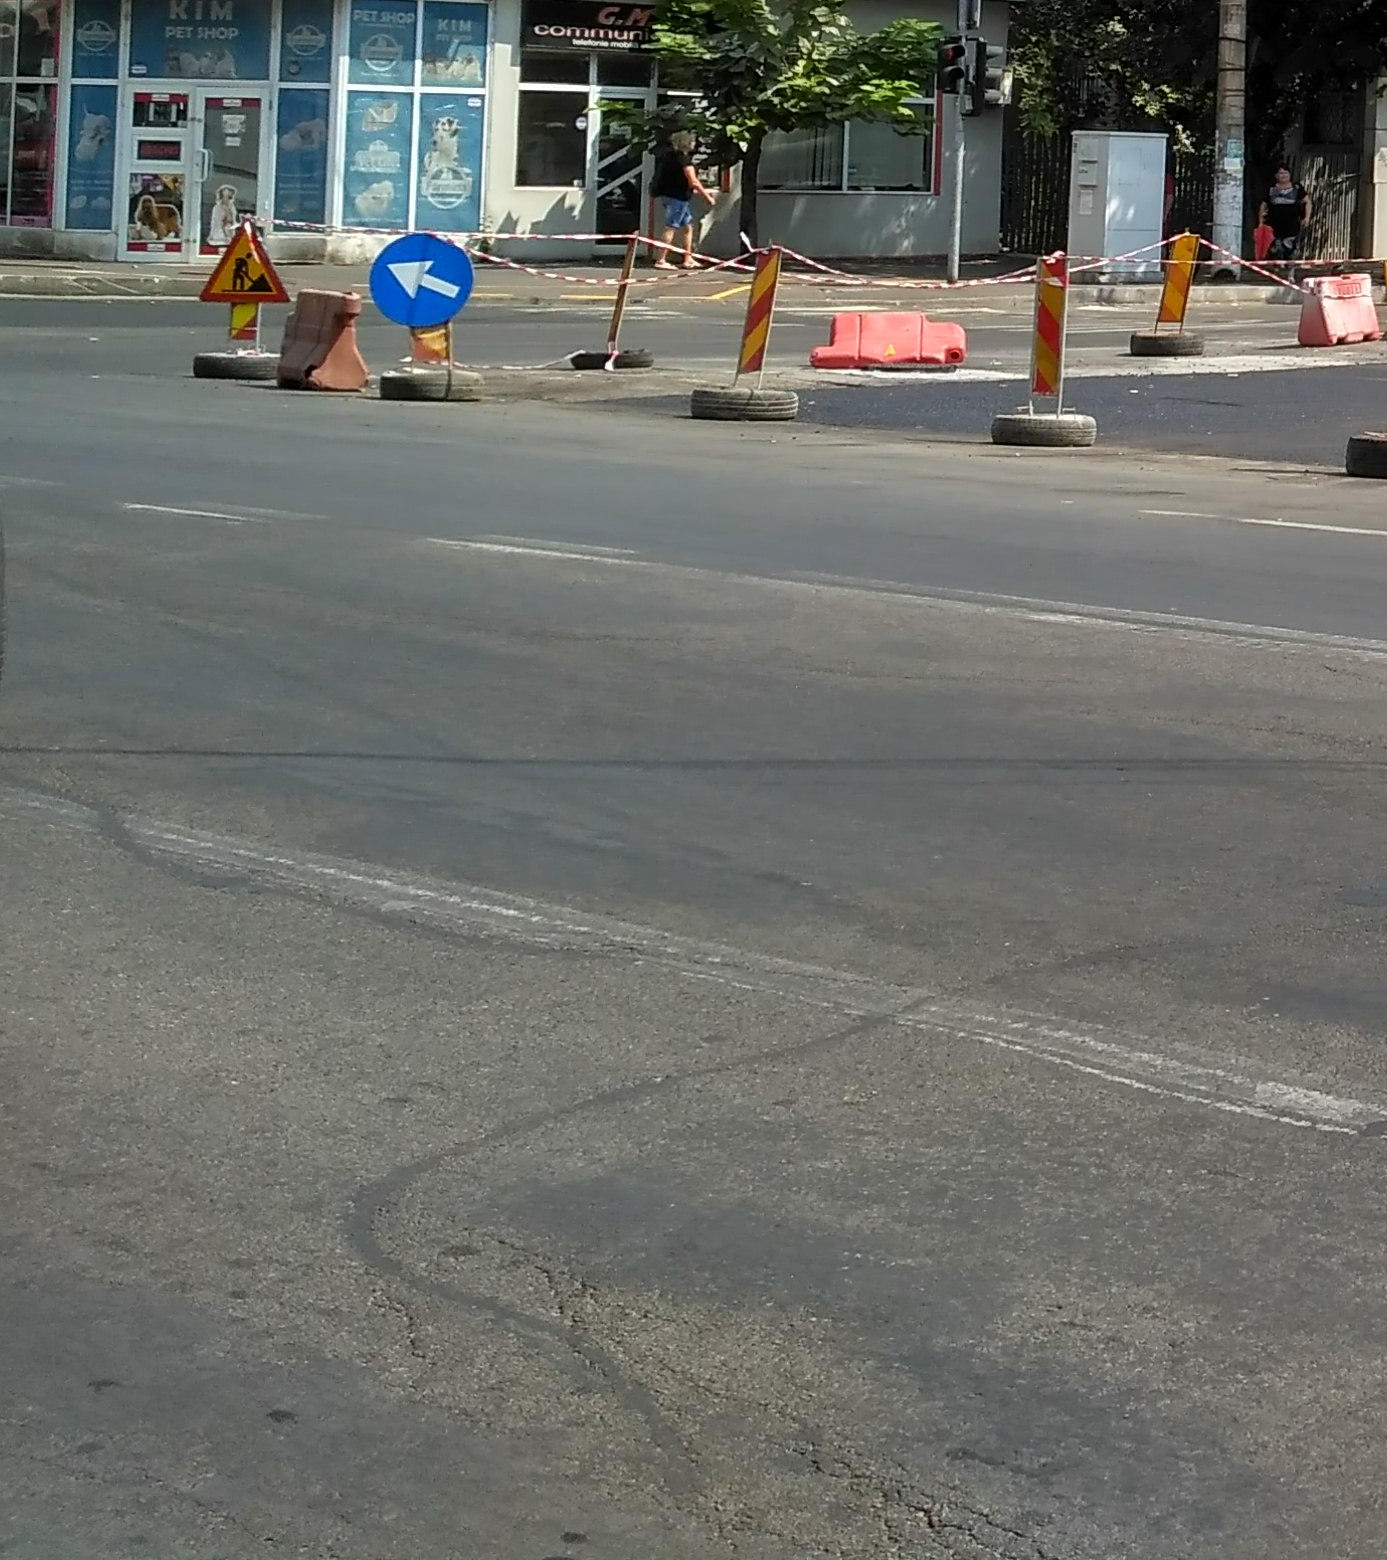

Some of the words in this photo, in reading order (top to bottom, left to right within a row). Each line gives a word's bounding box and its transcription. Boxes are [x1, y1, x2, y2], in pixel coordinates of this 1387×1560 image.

[352, 9, 378, 23] PET
[380, 10, 416, 25] SHOP
[165, 26, 193, 40] PET
[198, 27, 240, 41] SHOP
[572, 38, 609, 48] telefonie
